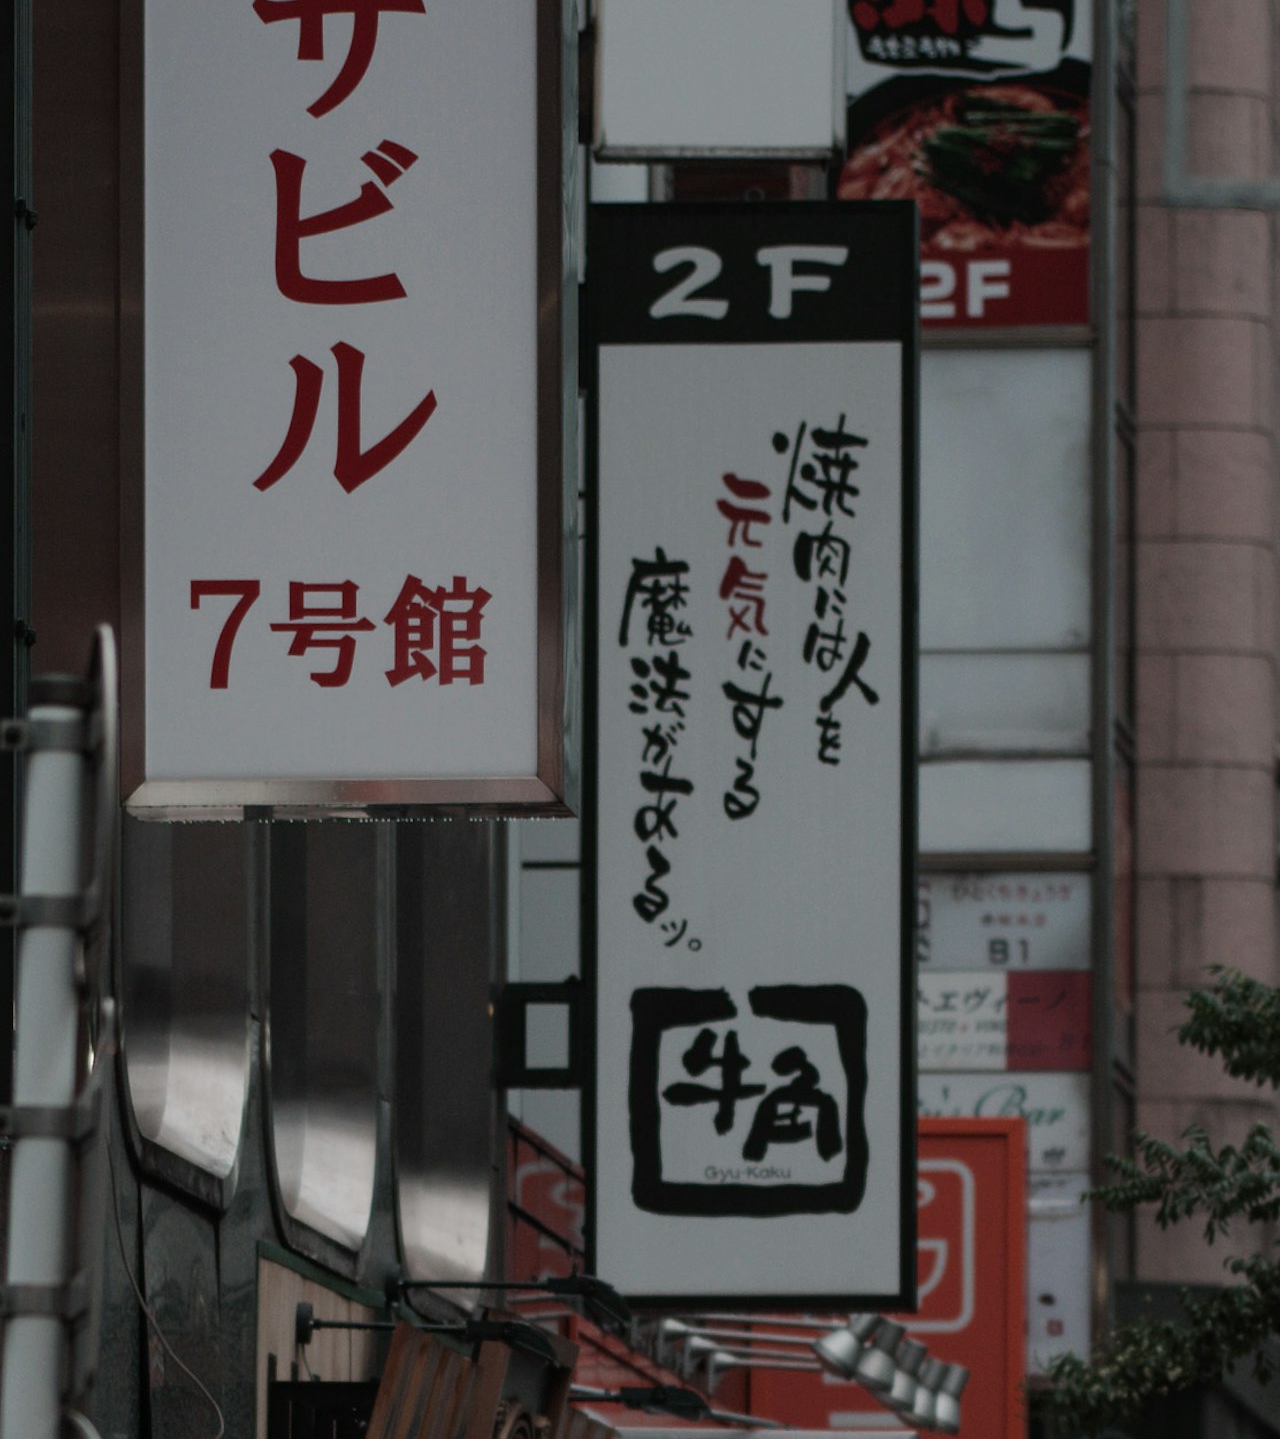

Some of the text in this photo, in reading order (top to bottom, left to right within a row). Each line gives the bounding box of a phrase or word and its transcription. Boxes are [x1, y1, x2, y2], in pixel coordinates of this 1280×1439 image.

[646, 243, 851, 321] 2F
[919, 257, 1014, 320] 2F
[188, 573, 493, 690] 7号館
[716, 471, 784, 821] 元気にする
[771, 413, 880, 766] 焼肉には人を
[662, 1027, 843, 1162] 牛角
[704, 1165, 793, 1183] Gyu-Kaku
